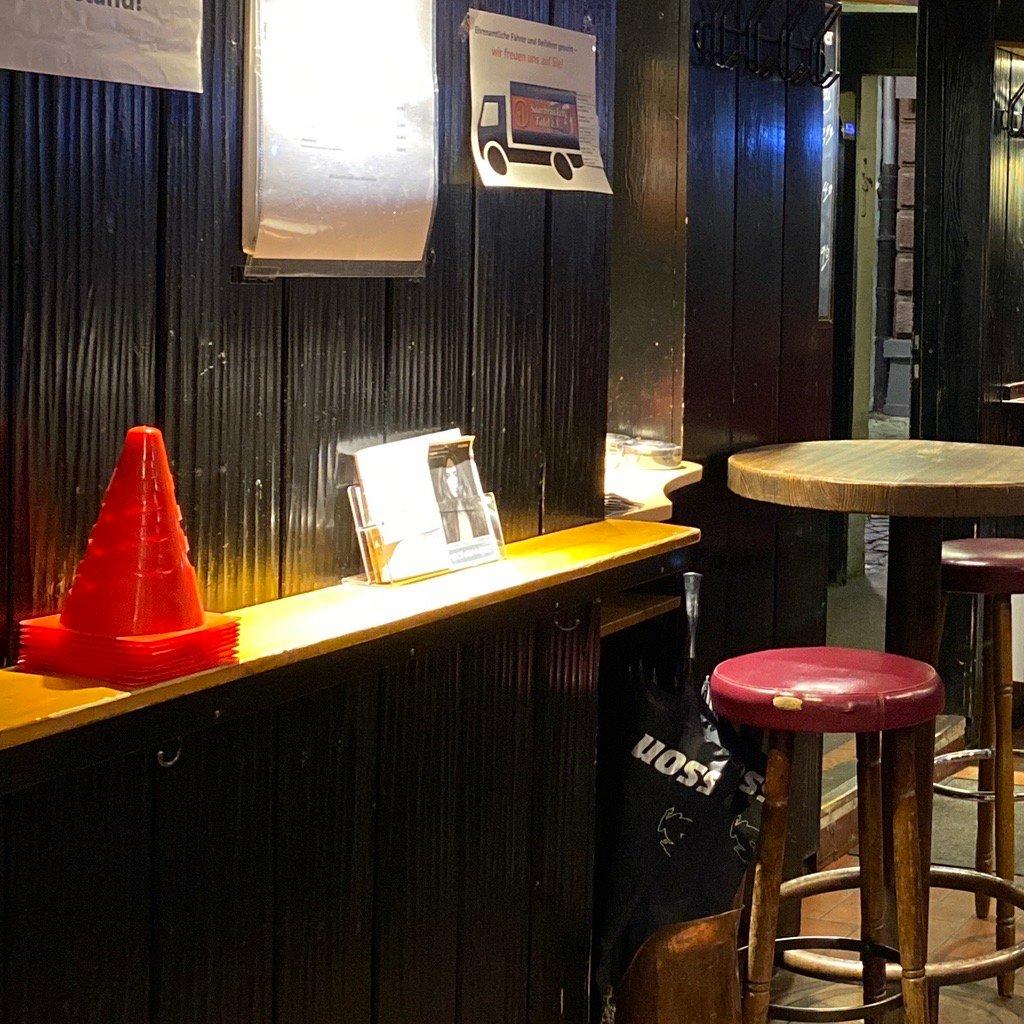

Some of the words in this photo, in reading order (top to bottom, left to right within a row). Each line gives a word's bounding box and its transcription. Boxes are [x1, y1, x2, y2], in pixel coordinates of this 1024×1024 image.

[504, 49, 526, 62] freuen
[527, 55, 539, 64] uns
[541, 56, 552, 66] auf
